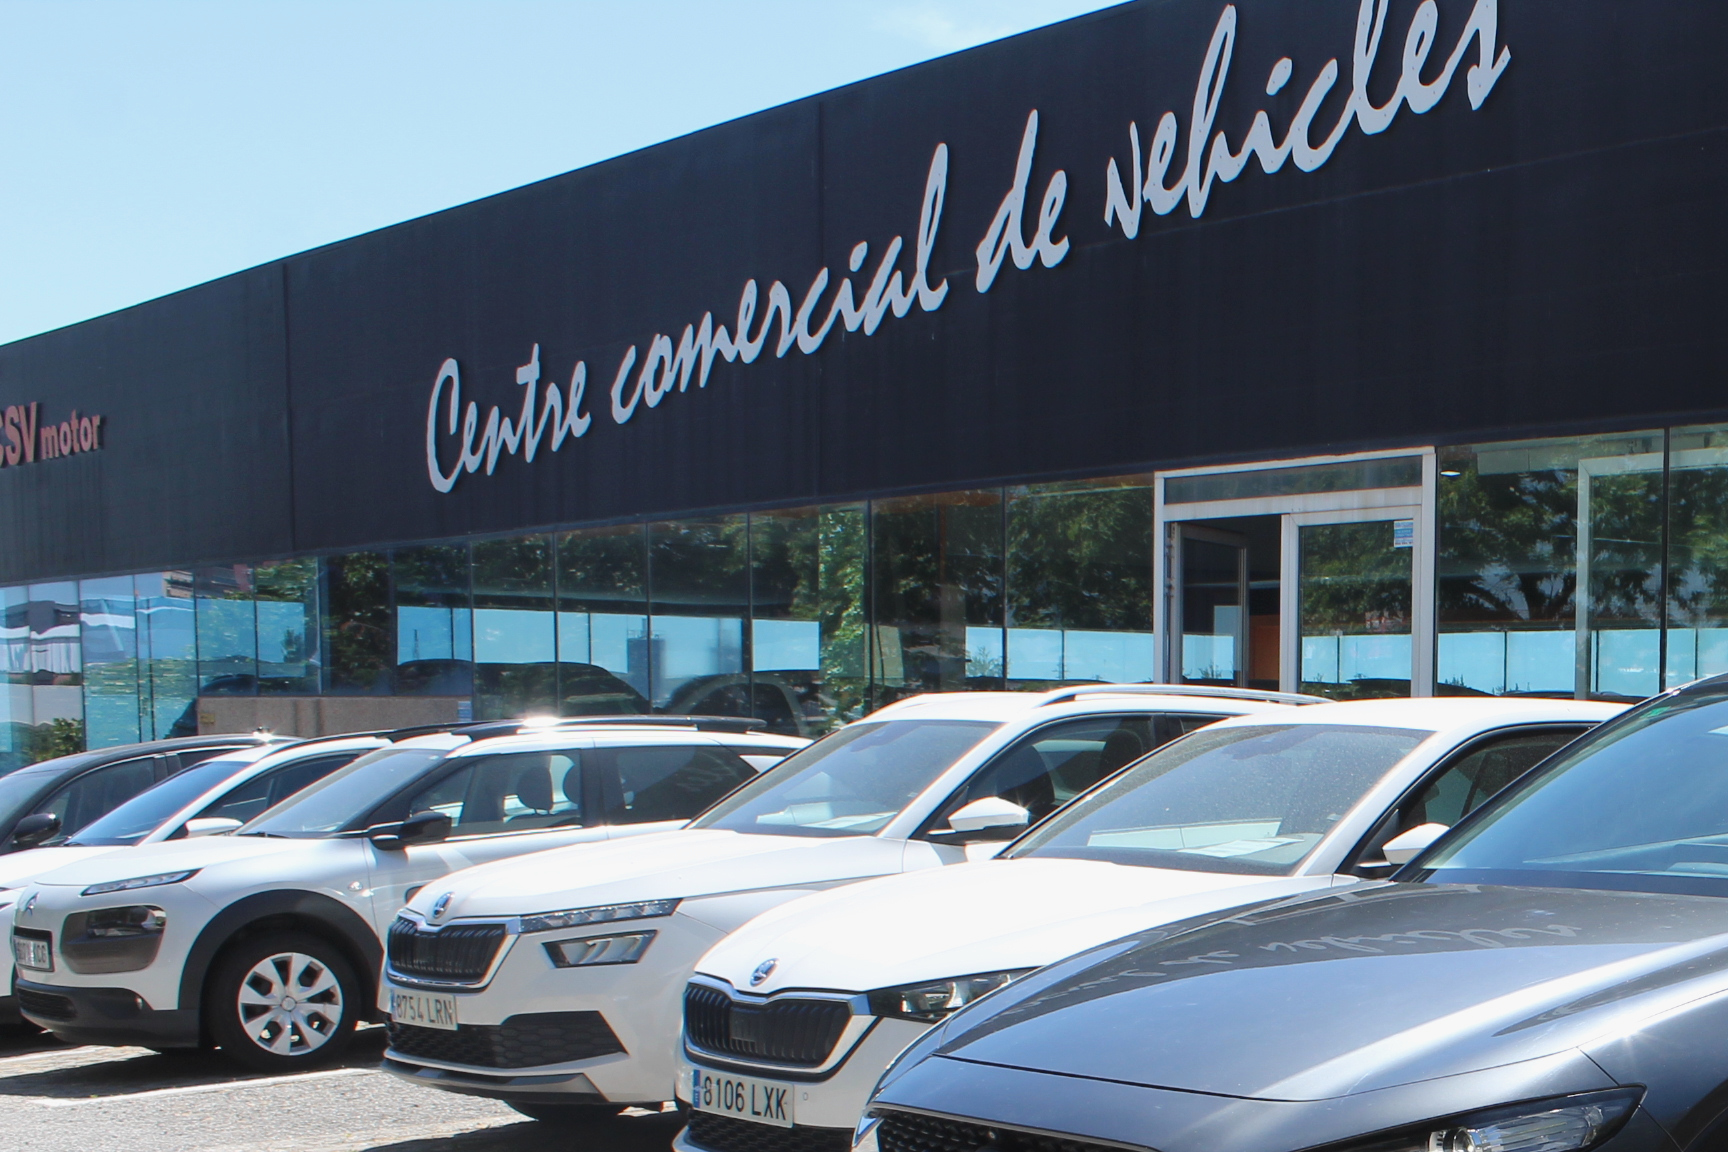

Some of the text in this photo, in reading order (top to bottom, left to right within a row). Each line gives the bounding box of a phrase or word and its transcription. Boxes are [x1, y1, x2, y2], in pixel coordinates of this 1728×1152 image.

[426, 0, 1512, 493] Centre comercial de vehicles
[40, 409, 101, 460] motor
[396, 993, 454, 1025] 8754 LRN
[703, 1075, 788, 1120] 8106 LXK
